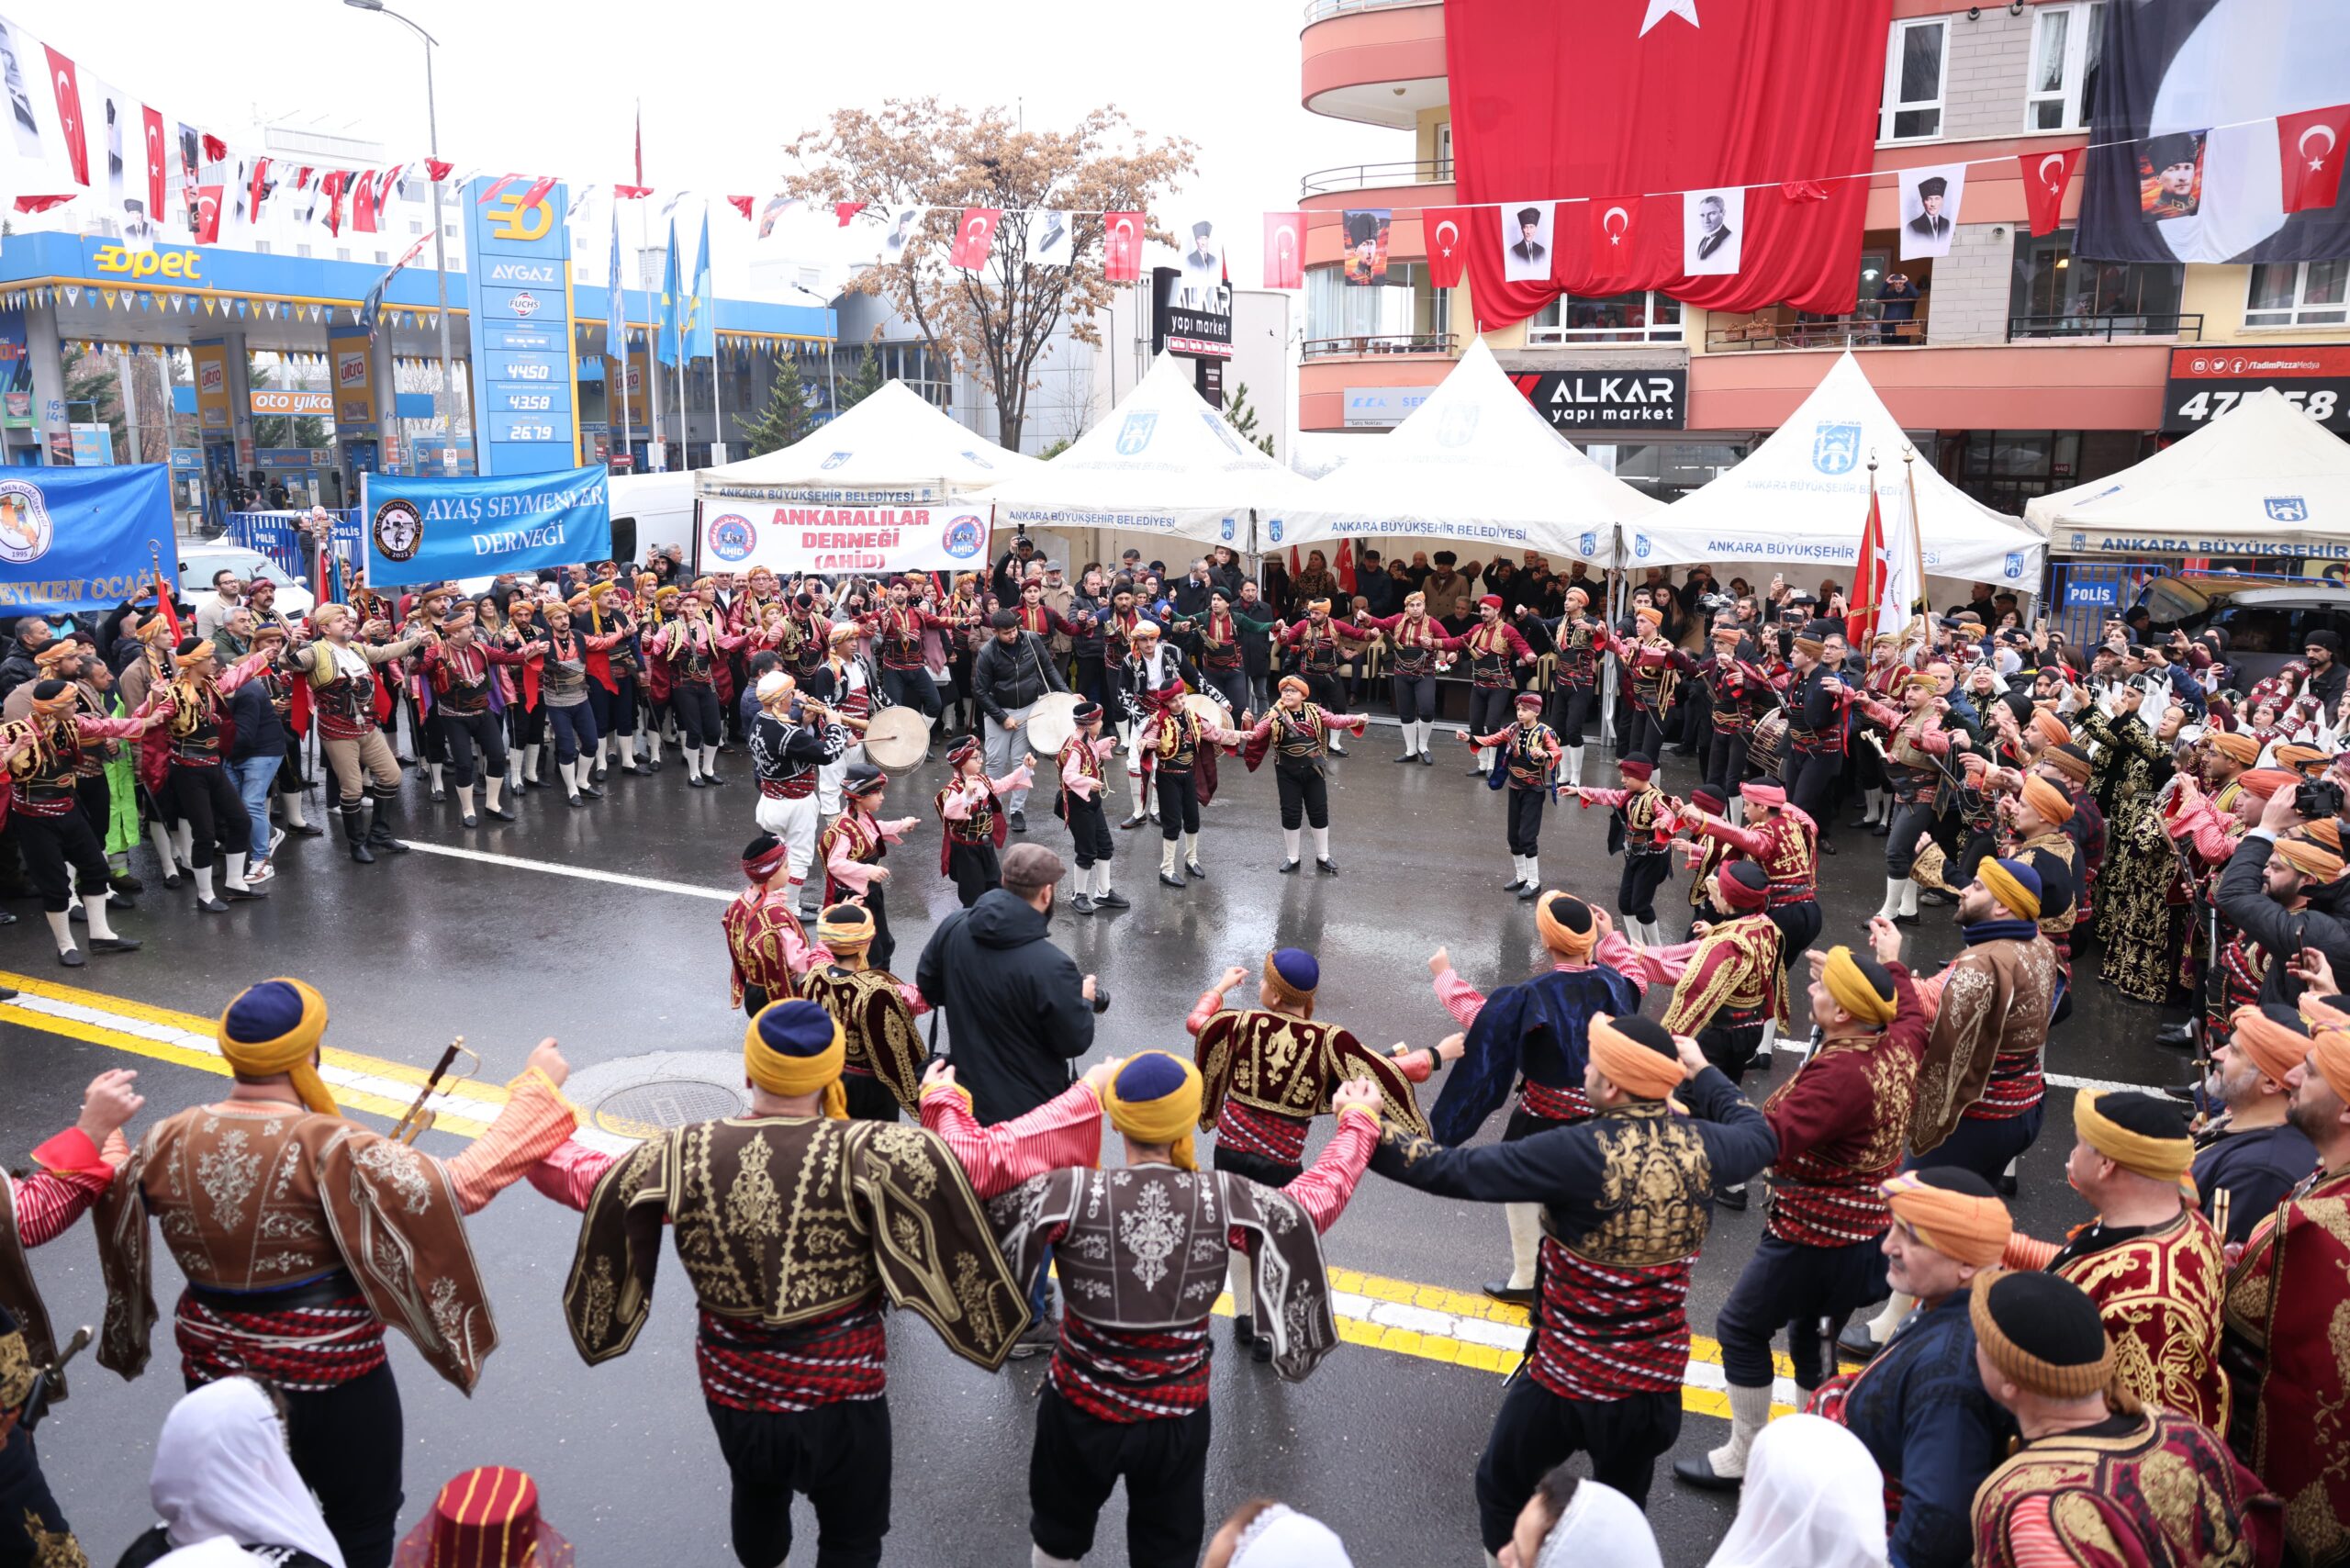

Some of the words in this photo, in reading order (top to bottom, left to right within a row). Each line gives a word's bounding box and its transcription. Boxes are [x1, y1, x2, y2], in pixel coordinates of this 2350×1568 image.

[492, 264, 554, 282] AYGAZ
[509, 299, 540, 308] FUCHS
[1171, 316, 1193, 334] yapı
[1195, 319, 1226, 336] market
[202, 368, 222, 387] ultra
[341, 362, 364, 381] ultra
[1550, 377, 1674, 403] ALKAR
[255, 395, 289, 408] oto
[1552, 409, 1595, 423] yapı
[1602, 408, 1674, 420] market
[720, 487, 765, 498] ANKARA
[767, 487, 842, 503] BÜYÜKŞEHİR
[845, 489, 914, 503] BELEDİYESİ
[425, 498, 482, 525] AYAŞ
[487, 485, 605, 519] SEYMENLER
[772, 508, 930, 526] ANKARALILAR
[1009, 510, 1049, 521] ANKARA
[1116, 513, 1176, 528] BELEDİYESİ
[255, 532, 276, 543] POLİS
[472, 519, 566, 556] DERNEĞİ
[802, 528, 901, 549] DERNEĞİ
[1331, 520, 1378, 532] ANKARA
[1381, 519, 1455, 536] BÜYÜKŞEHİR
[1457, 522, 1527, 541] BELEDİYESİ
[719, 544, 744, 555] AHİD
[951, 543, 975, 553] AHİD
[1707, 540, 1762, 554] ANKARA
[1766, 540, 1854, 560] BÜYÜKŞEHİR
[2101, 537, 2189, 553] ANKARA
[814, 550, 886, 570] (AHİD)
[2070, 584, 2110, 601] POLİS
